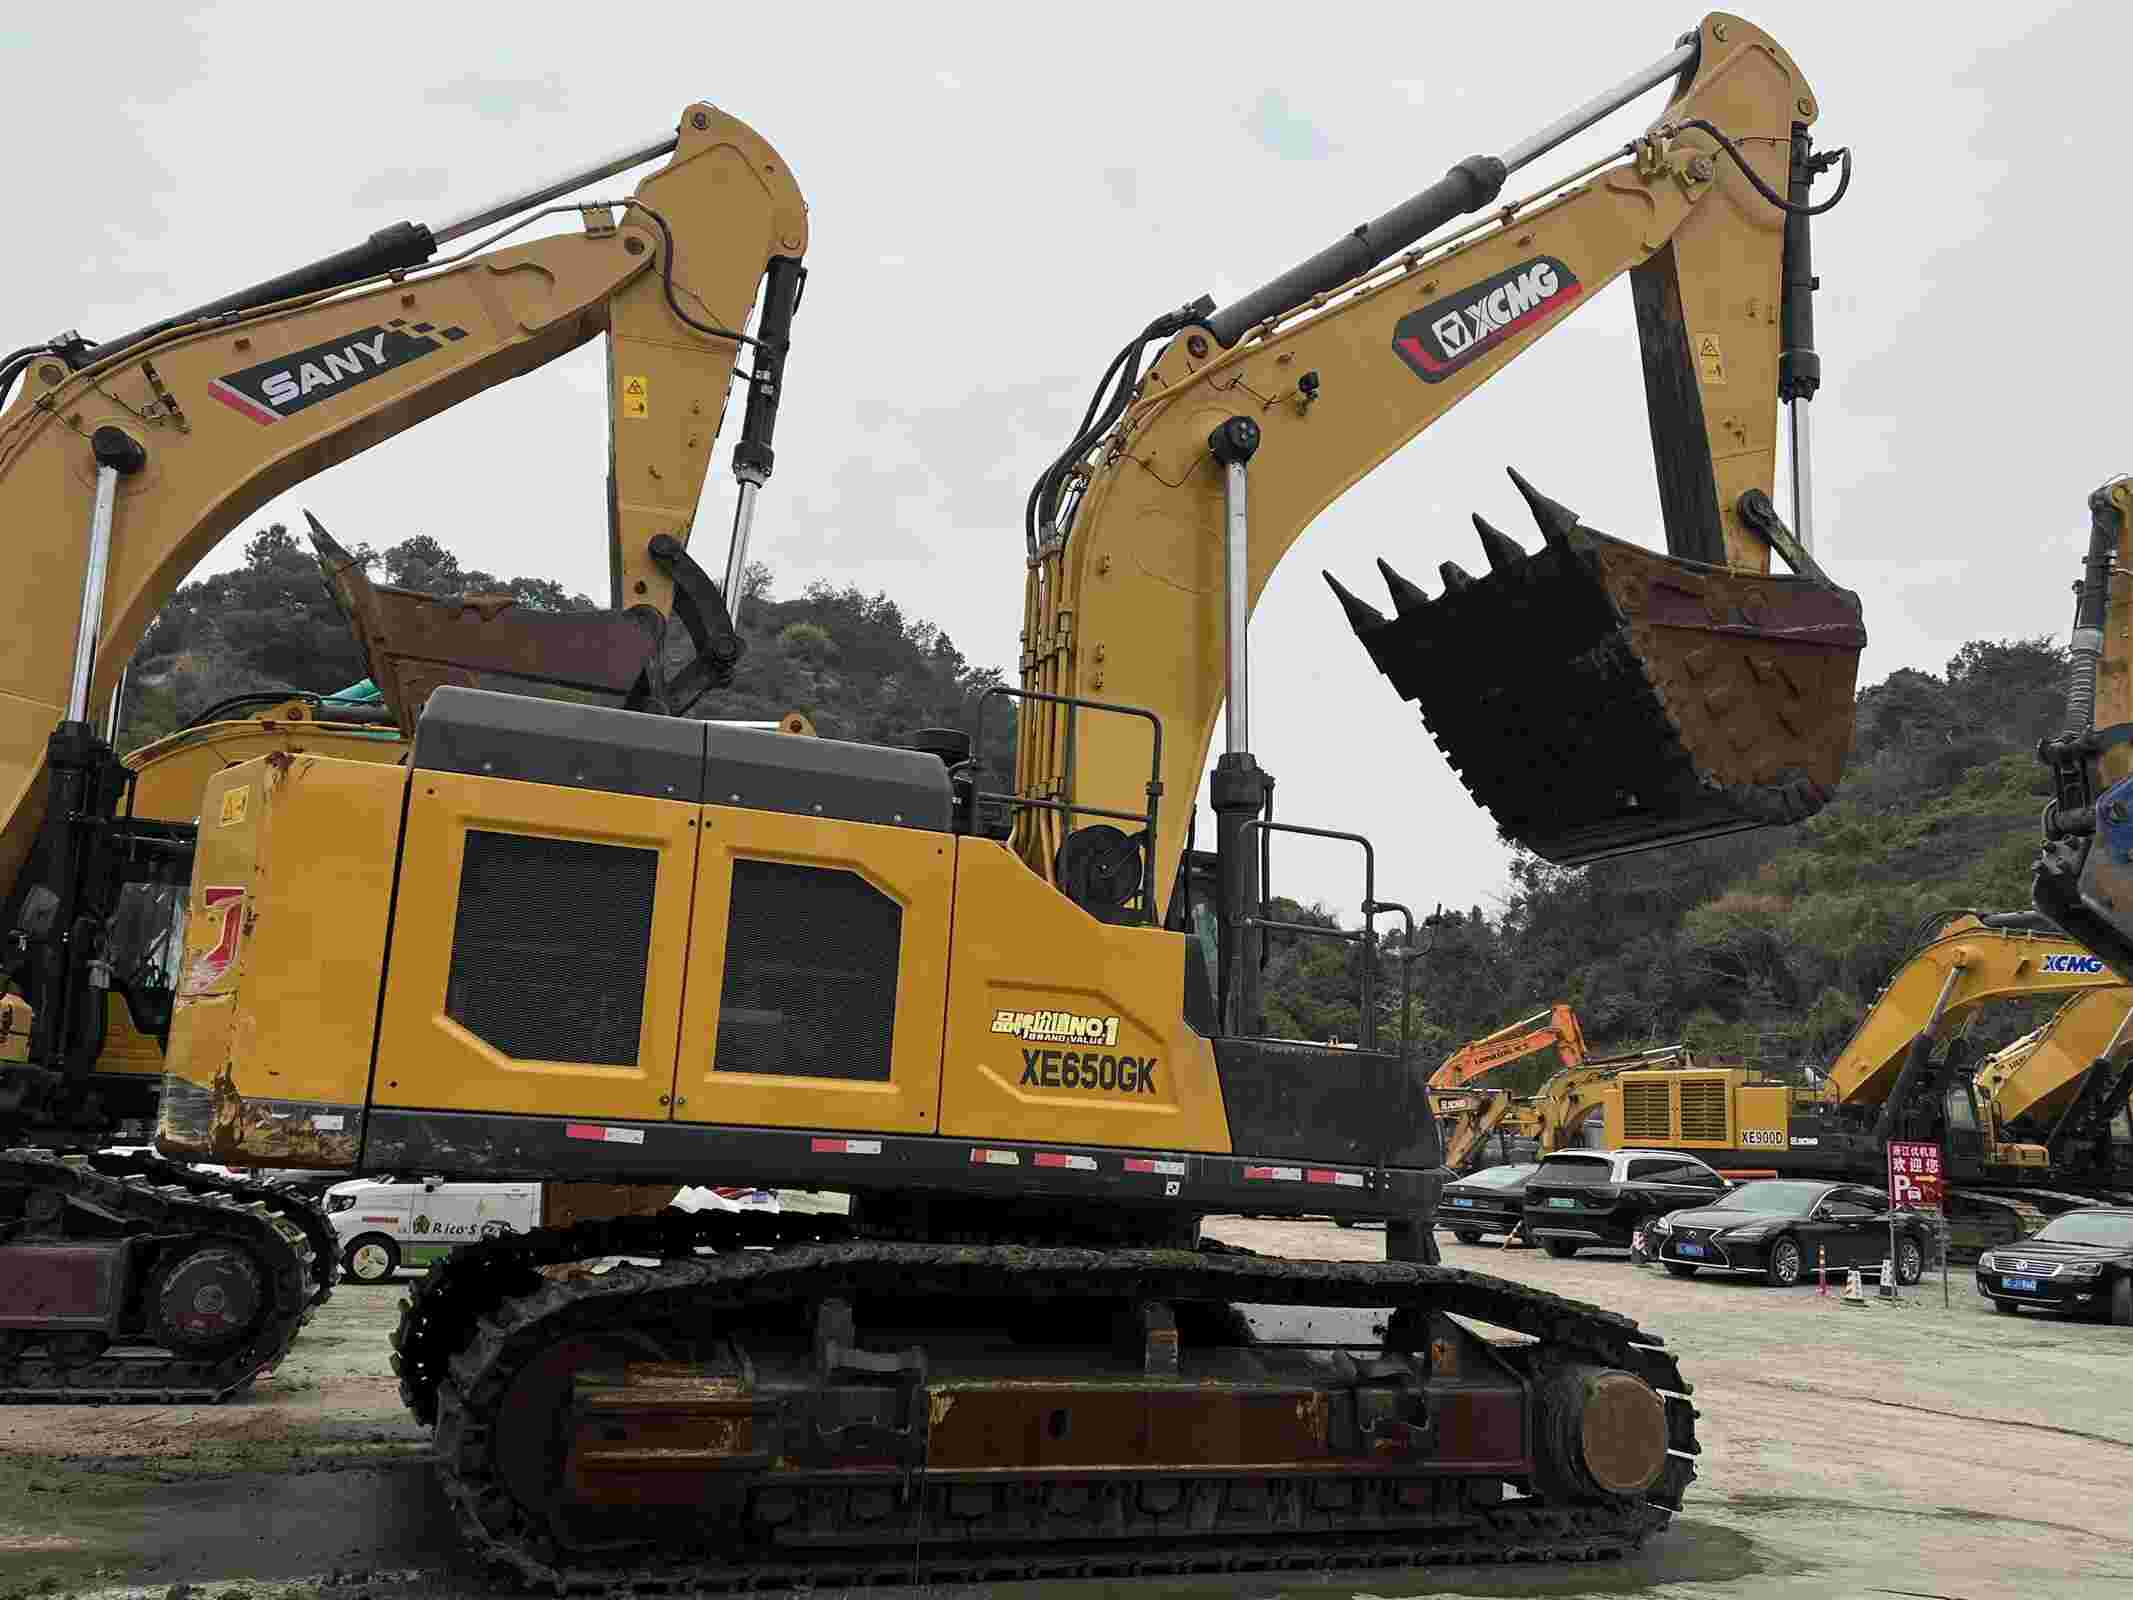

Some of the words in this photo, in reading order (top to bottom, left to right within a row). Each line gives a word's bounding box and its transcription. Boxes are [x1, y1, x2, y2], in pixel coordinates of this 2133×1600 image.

[1464, 263, 1559, 343] XCMG
[260, 332, 388, 407] SANY
[2043, 954, 2105, 974] XCMG
[1021, 1048, 1158, 1095] XE650GK
[1742, 1130, 1784, 1145] XE900D
